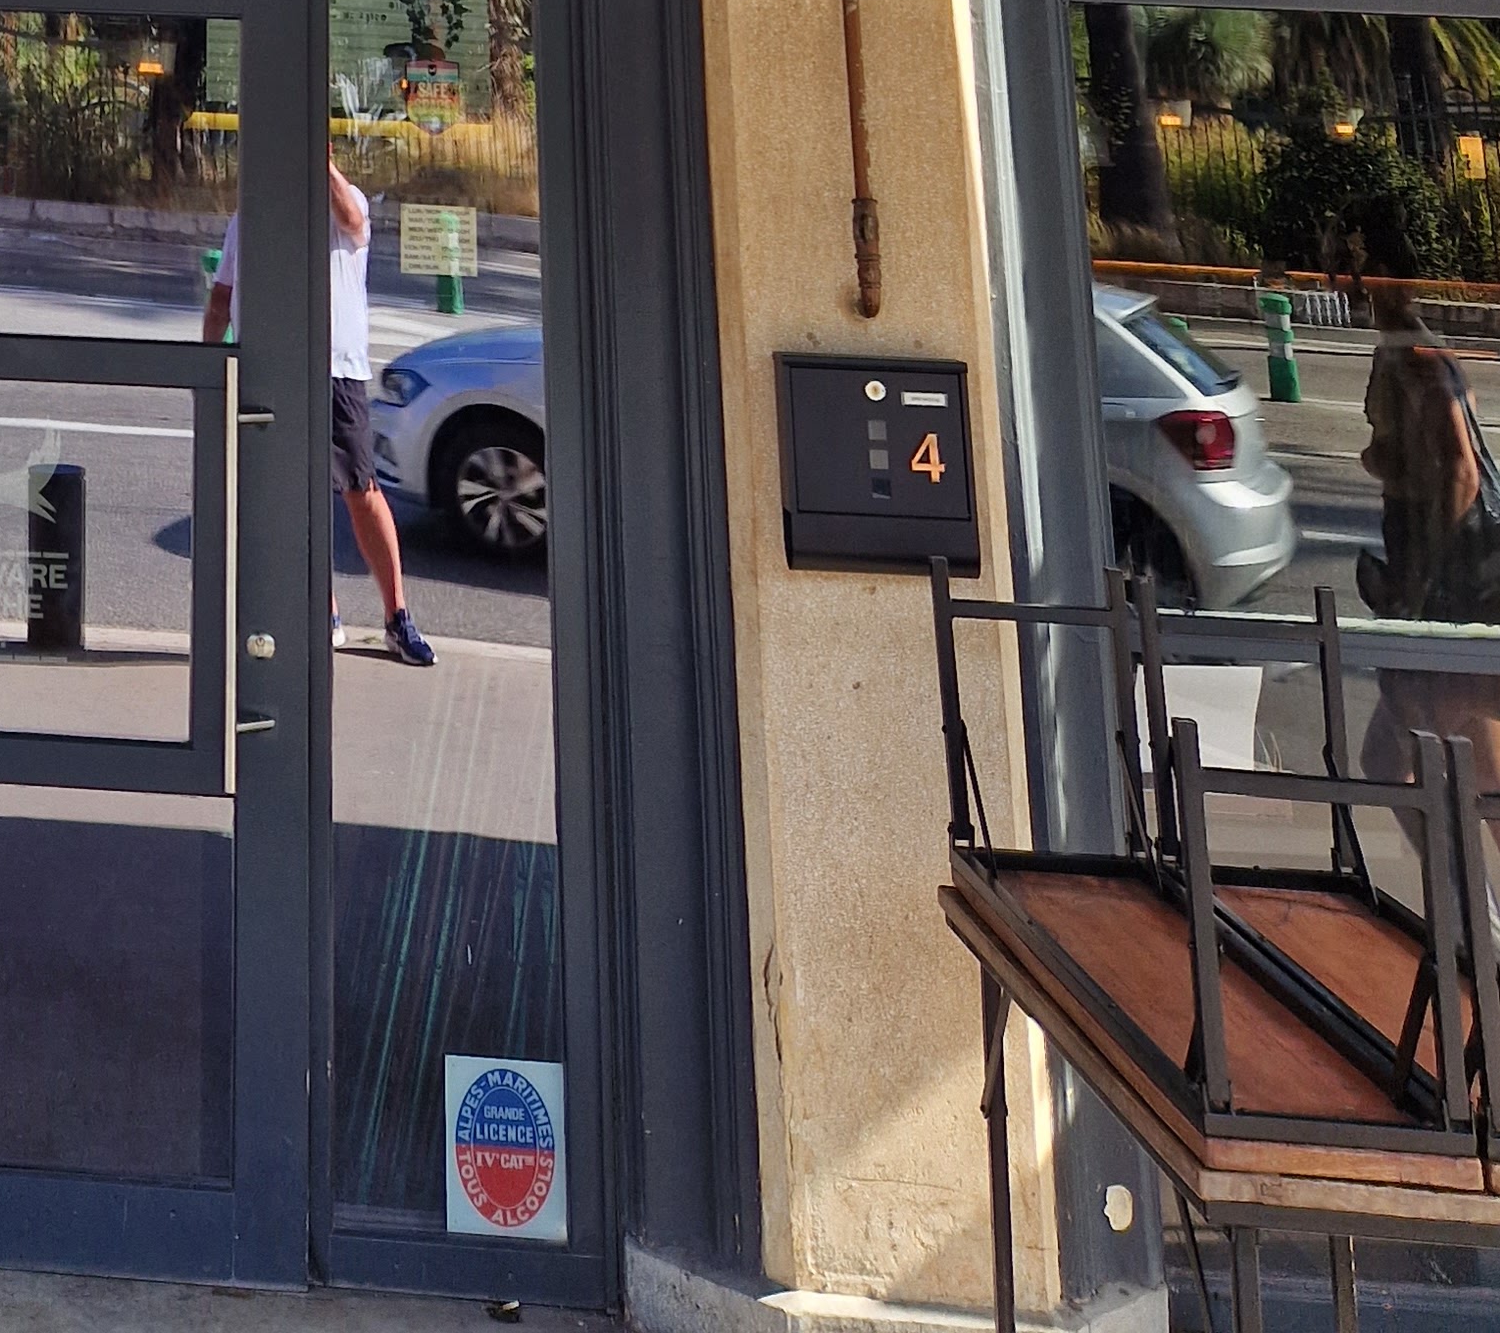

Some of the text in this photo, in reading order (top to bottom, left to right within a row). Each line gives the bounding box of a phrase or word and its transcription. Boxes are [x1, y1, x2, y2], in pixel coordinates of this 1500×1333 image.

[417, 82, 449, 99] SAFE
[911, 433, 946, 483] 4
[458, 1070, 554, 1149] ALPES-MARITIMES
[484, 1105, 525, 1121] GRANDE
[475, 1122, 534, 1144] LICENCE
[458, 1150, 553, 1226] TOUS ALCOOLS
